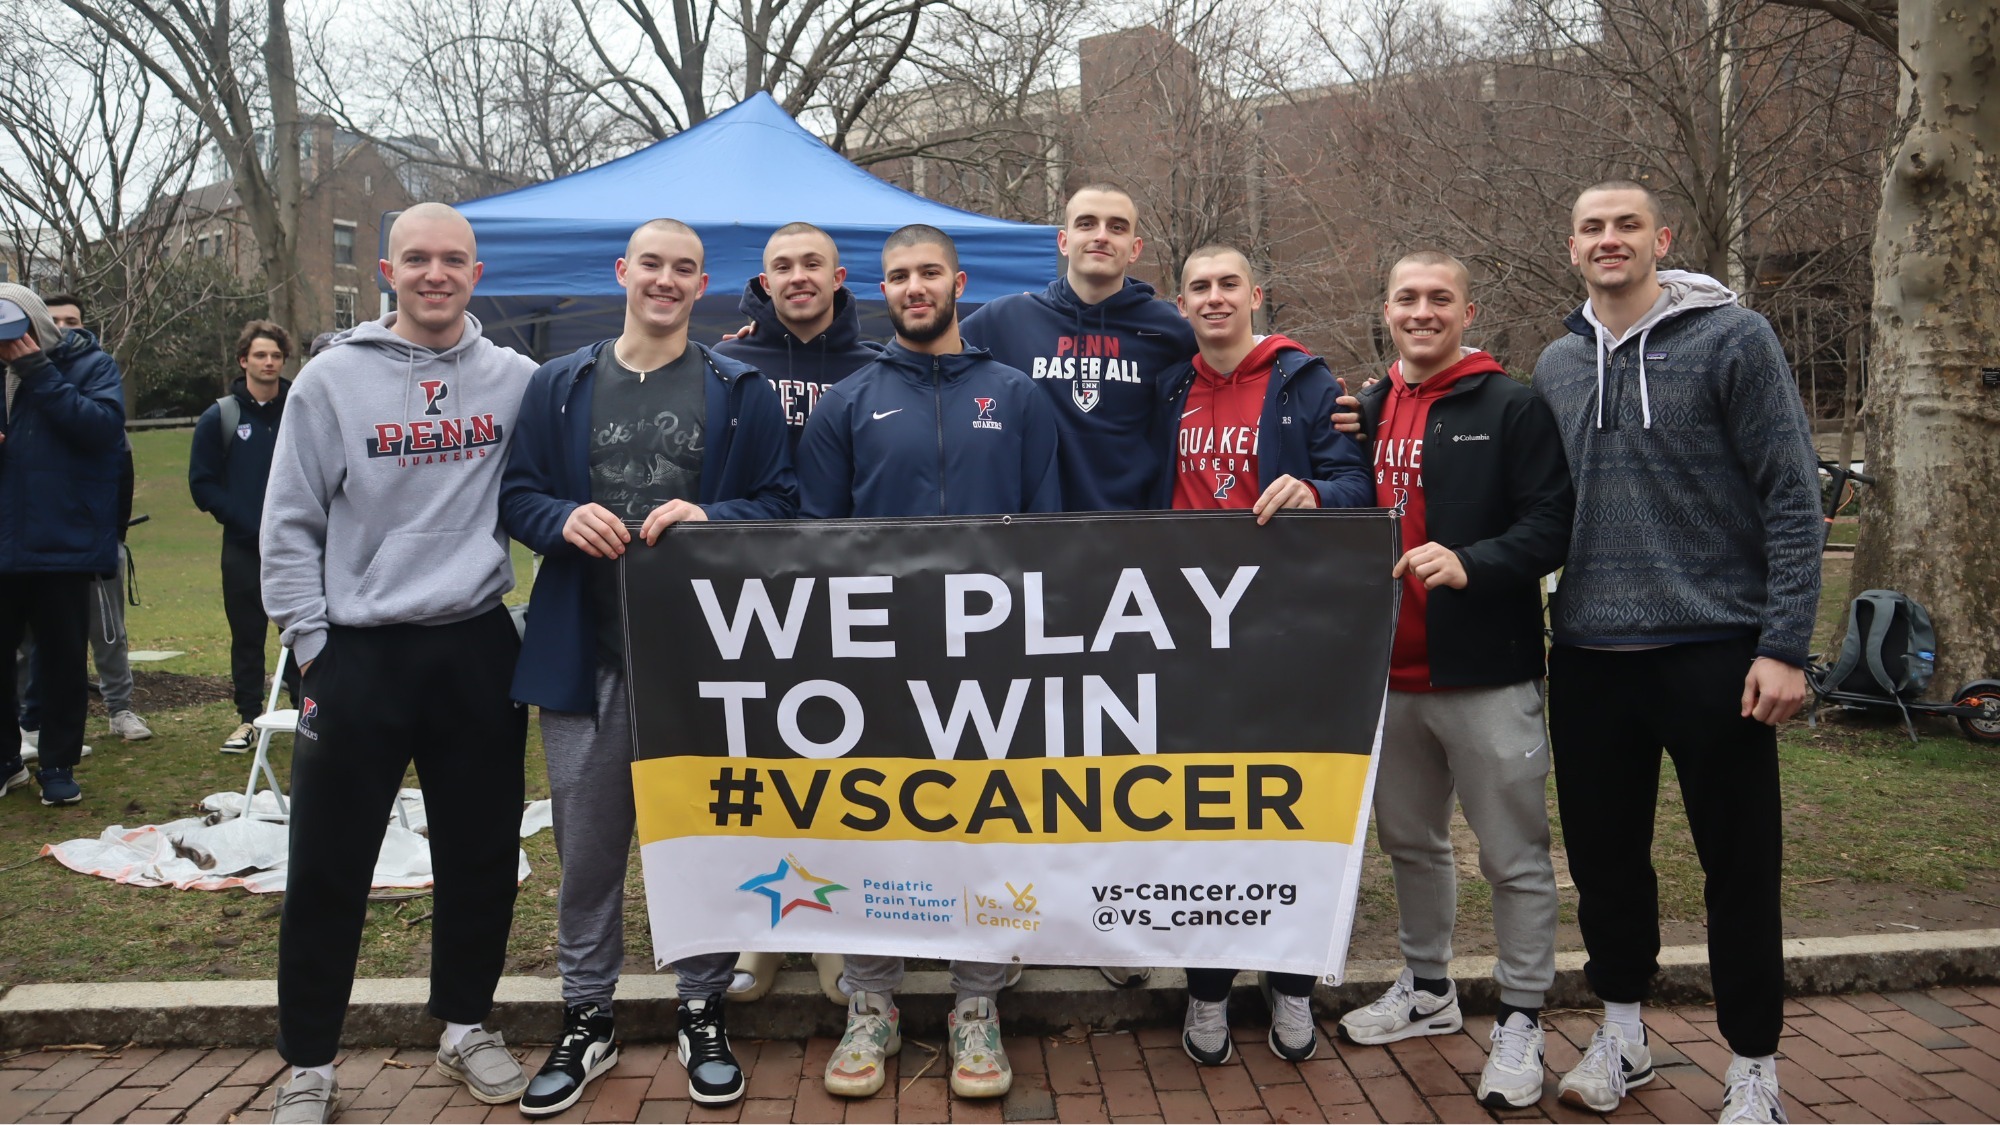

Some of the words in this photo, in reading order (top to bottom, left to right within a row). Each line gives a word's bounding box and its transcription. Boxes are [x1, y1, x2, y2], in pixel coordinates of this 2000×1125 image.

[1057, 335, 1119, 357] PENN
[1032, 357, 1141, 383] BASEBALL
[418, 380, 449, 416] P
[974, 398, 996, 420] P
[374, 413, 495, 453] PENN
[972, 421, 1002, 430] QUAKERS
[398, 449, 486, 467] QUAKERS
[1214, 473, 1235, 499] P
[690, 575, 896, 660] WE
[945, 566, 1260, 657] PLAY
[300, 696, 318, 728] P
[698, 679, 865, 759] TO
[906, 673, 1157, 760] WIN
[709, 764, 1305, 834] #VSCANCER
[863, 879, 933, 891] Pediatric
[1091, 883, 1297, 906] vs-cancer.org
[864, 894, 904, 906] Brain
[908, 896, 957, 907] Tumor
[975, 895, 1003, 910] Vs.
[866, 909, 950, 922] Foundation
[976, 913, 1041, 932] Cancer
[1092, 906, 1271, 932] @vs_cancer
